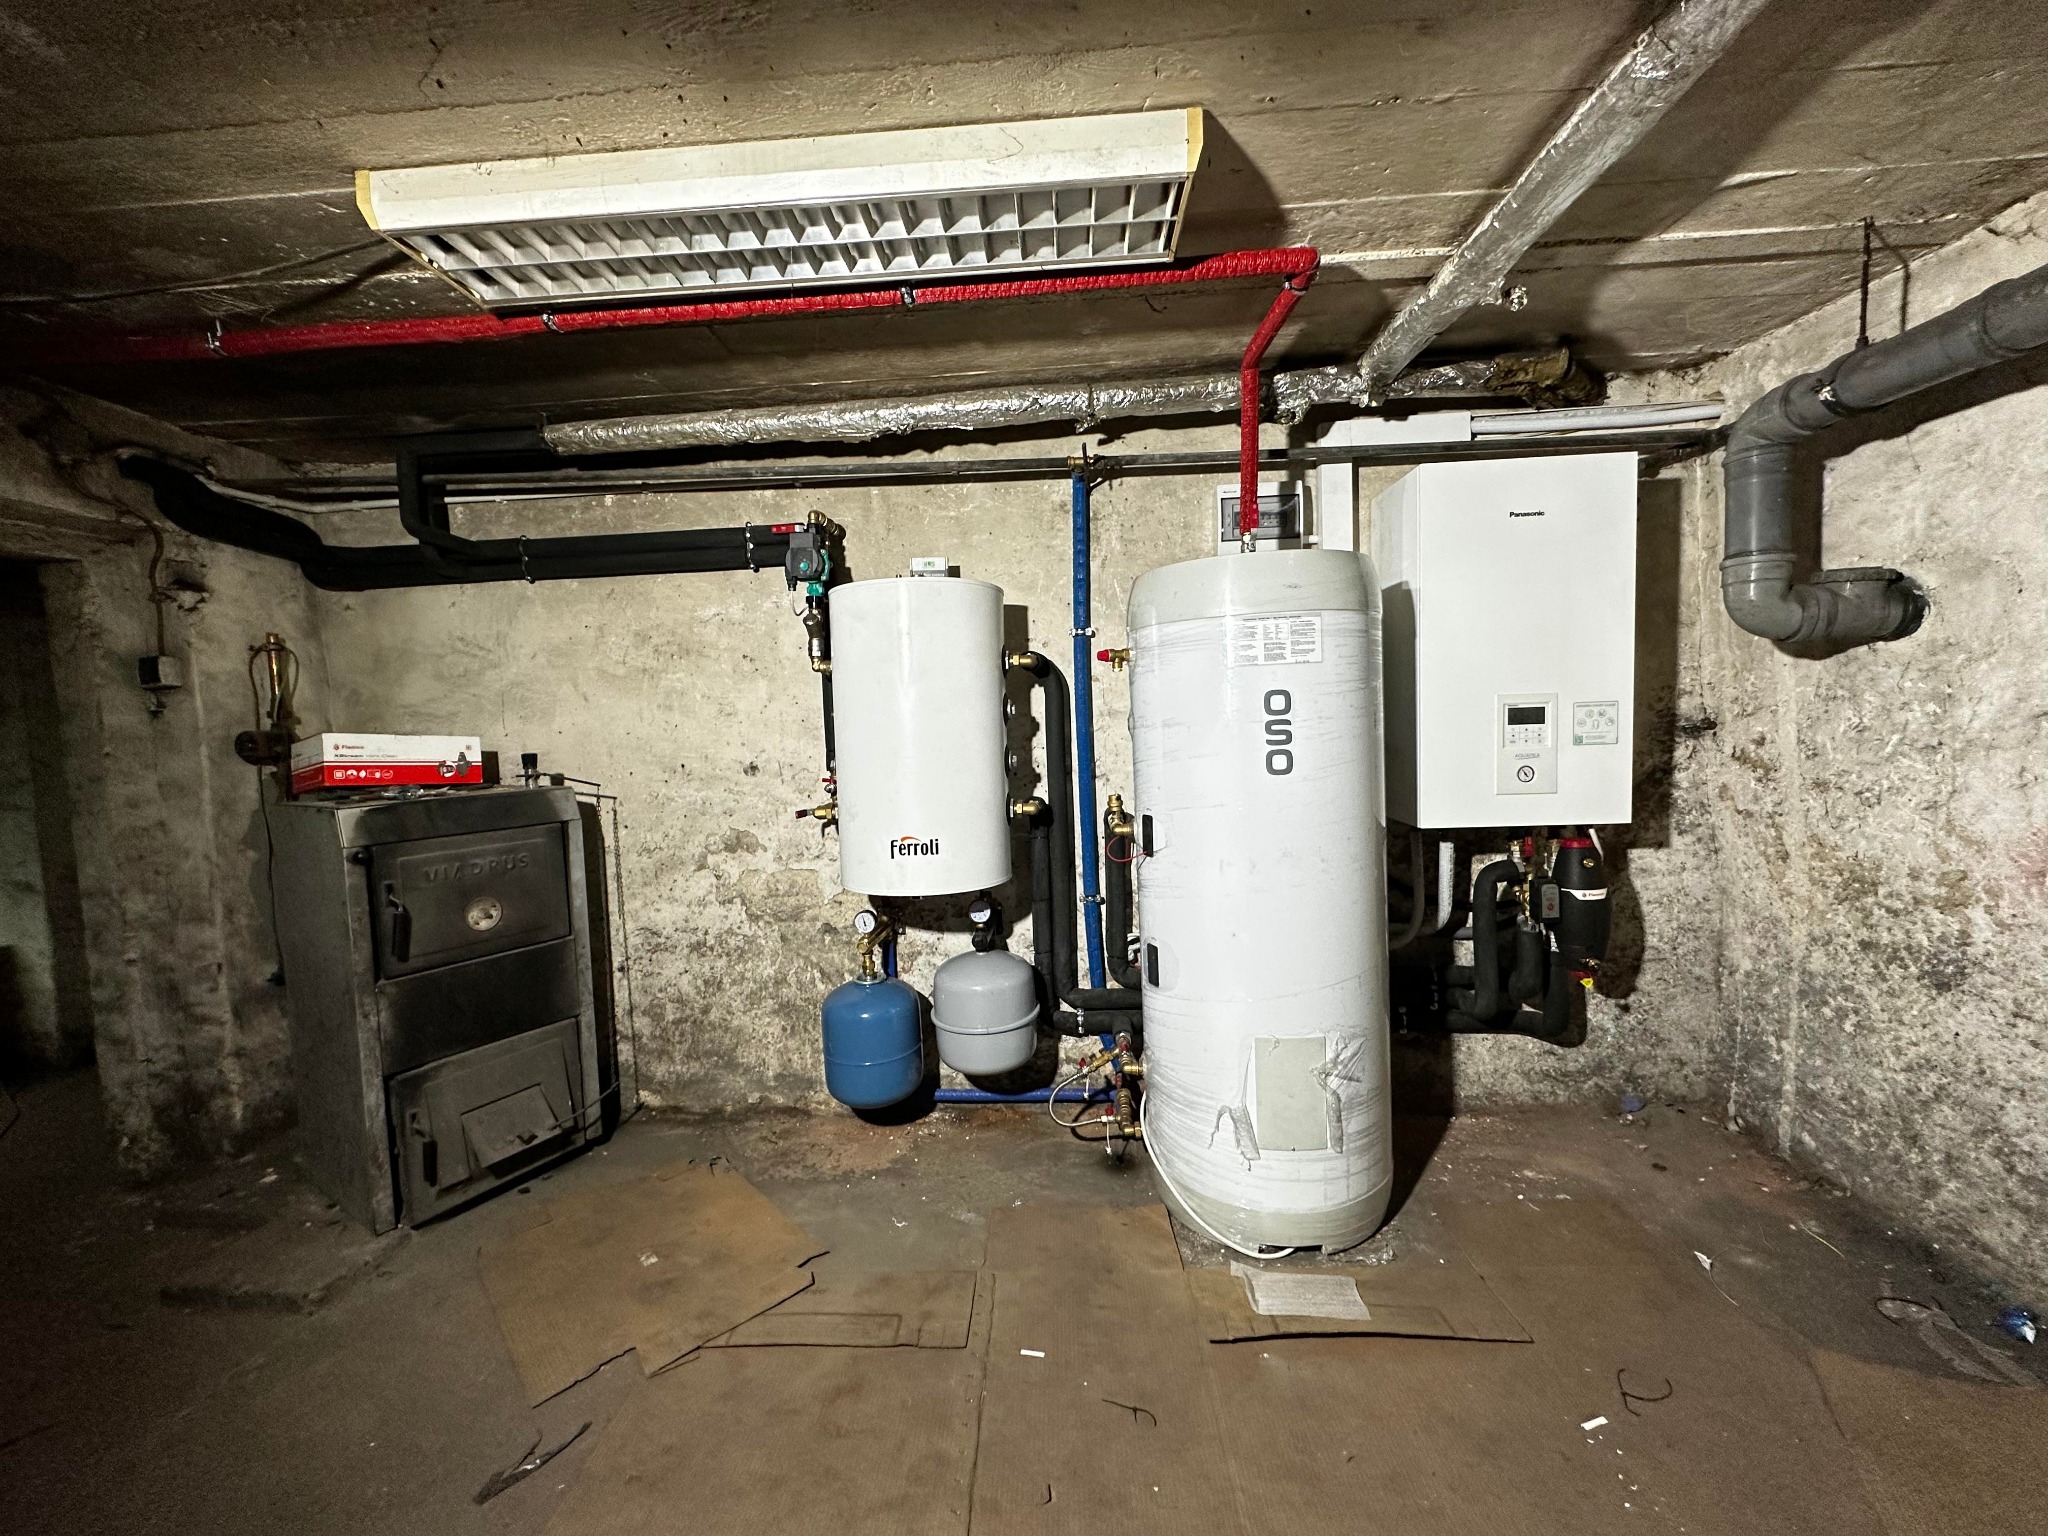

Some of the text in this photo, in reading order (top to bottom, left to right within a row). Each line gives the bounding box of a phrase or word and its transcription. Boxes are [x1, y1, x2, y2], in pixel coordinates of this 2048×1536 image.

[1509, 509, 1545, 518] Panasonic
[1263, 689, 1294, 776] OSO
[890, 838, 939, 860] Ferroli
[423, 852, 529, 882] VIADRUS
